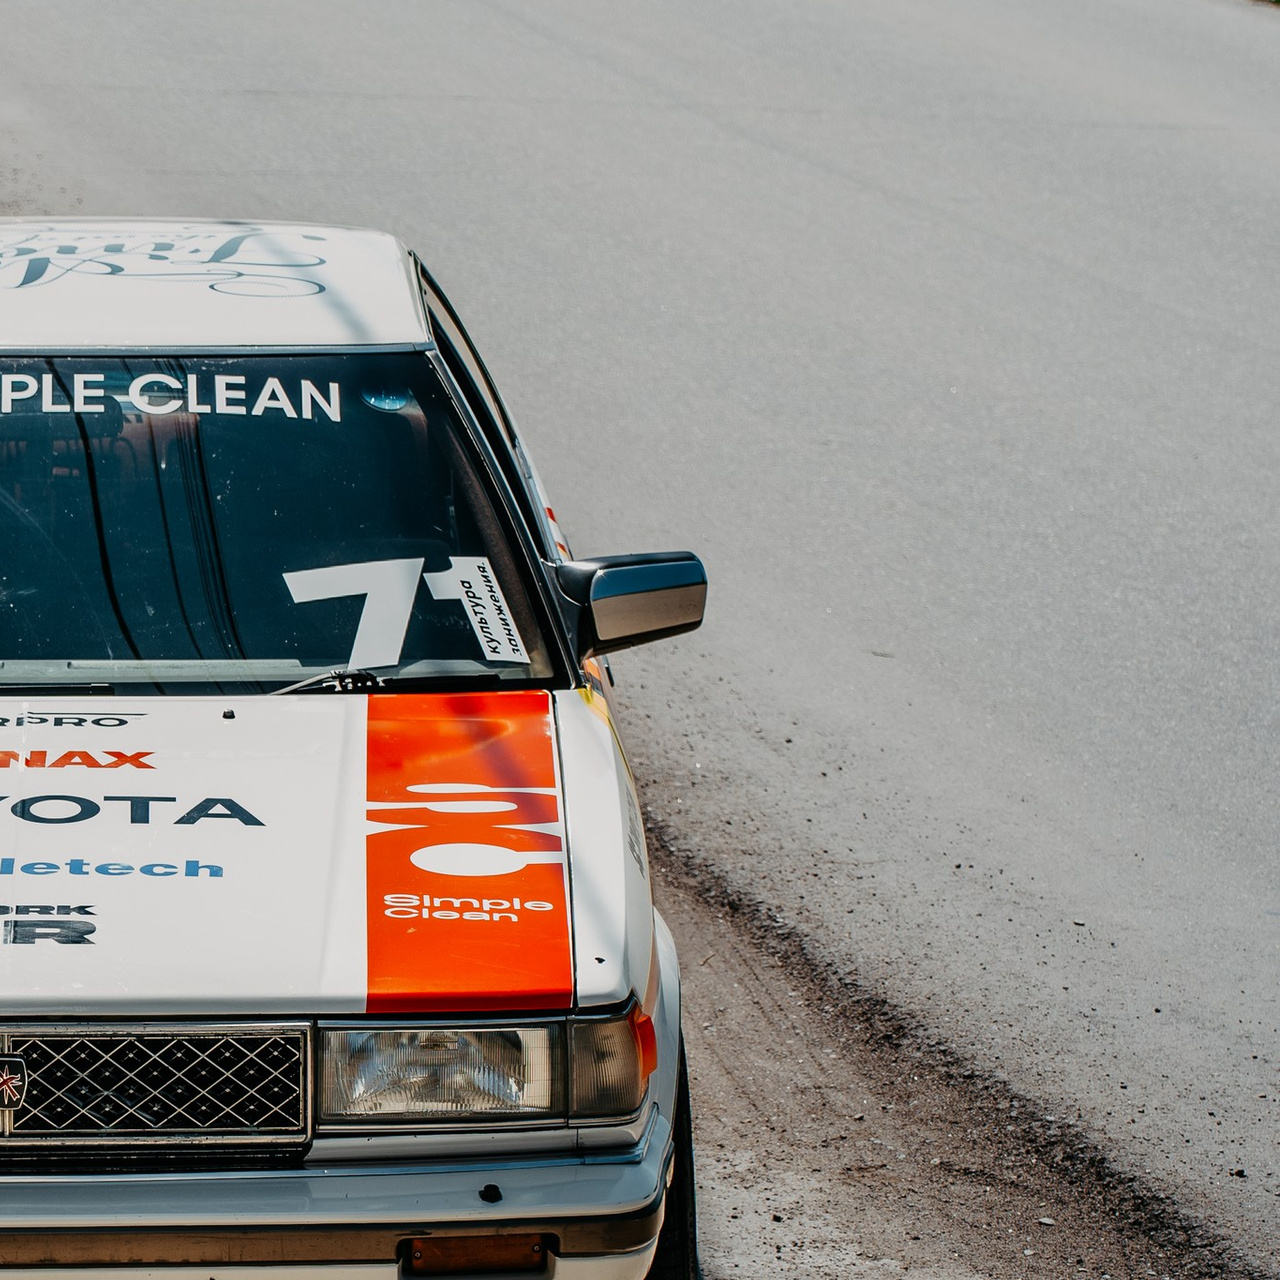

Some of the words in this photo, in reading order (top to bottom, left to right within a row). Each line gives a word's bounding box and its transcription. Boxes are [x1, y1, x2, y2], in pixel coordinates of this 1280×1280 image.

[128, 372, 341, 423] CLEAN
[383, 893, 554, 912] Simple
[384, 907, 519, 922] Clean
